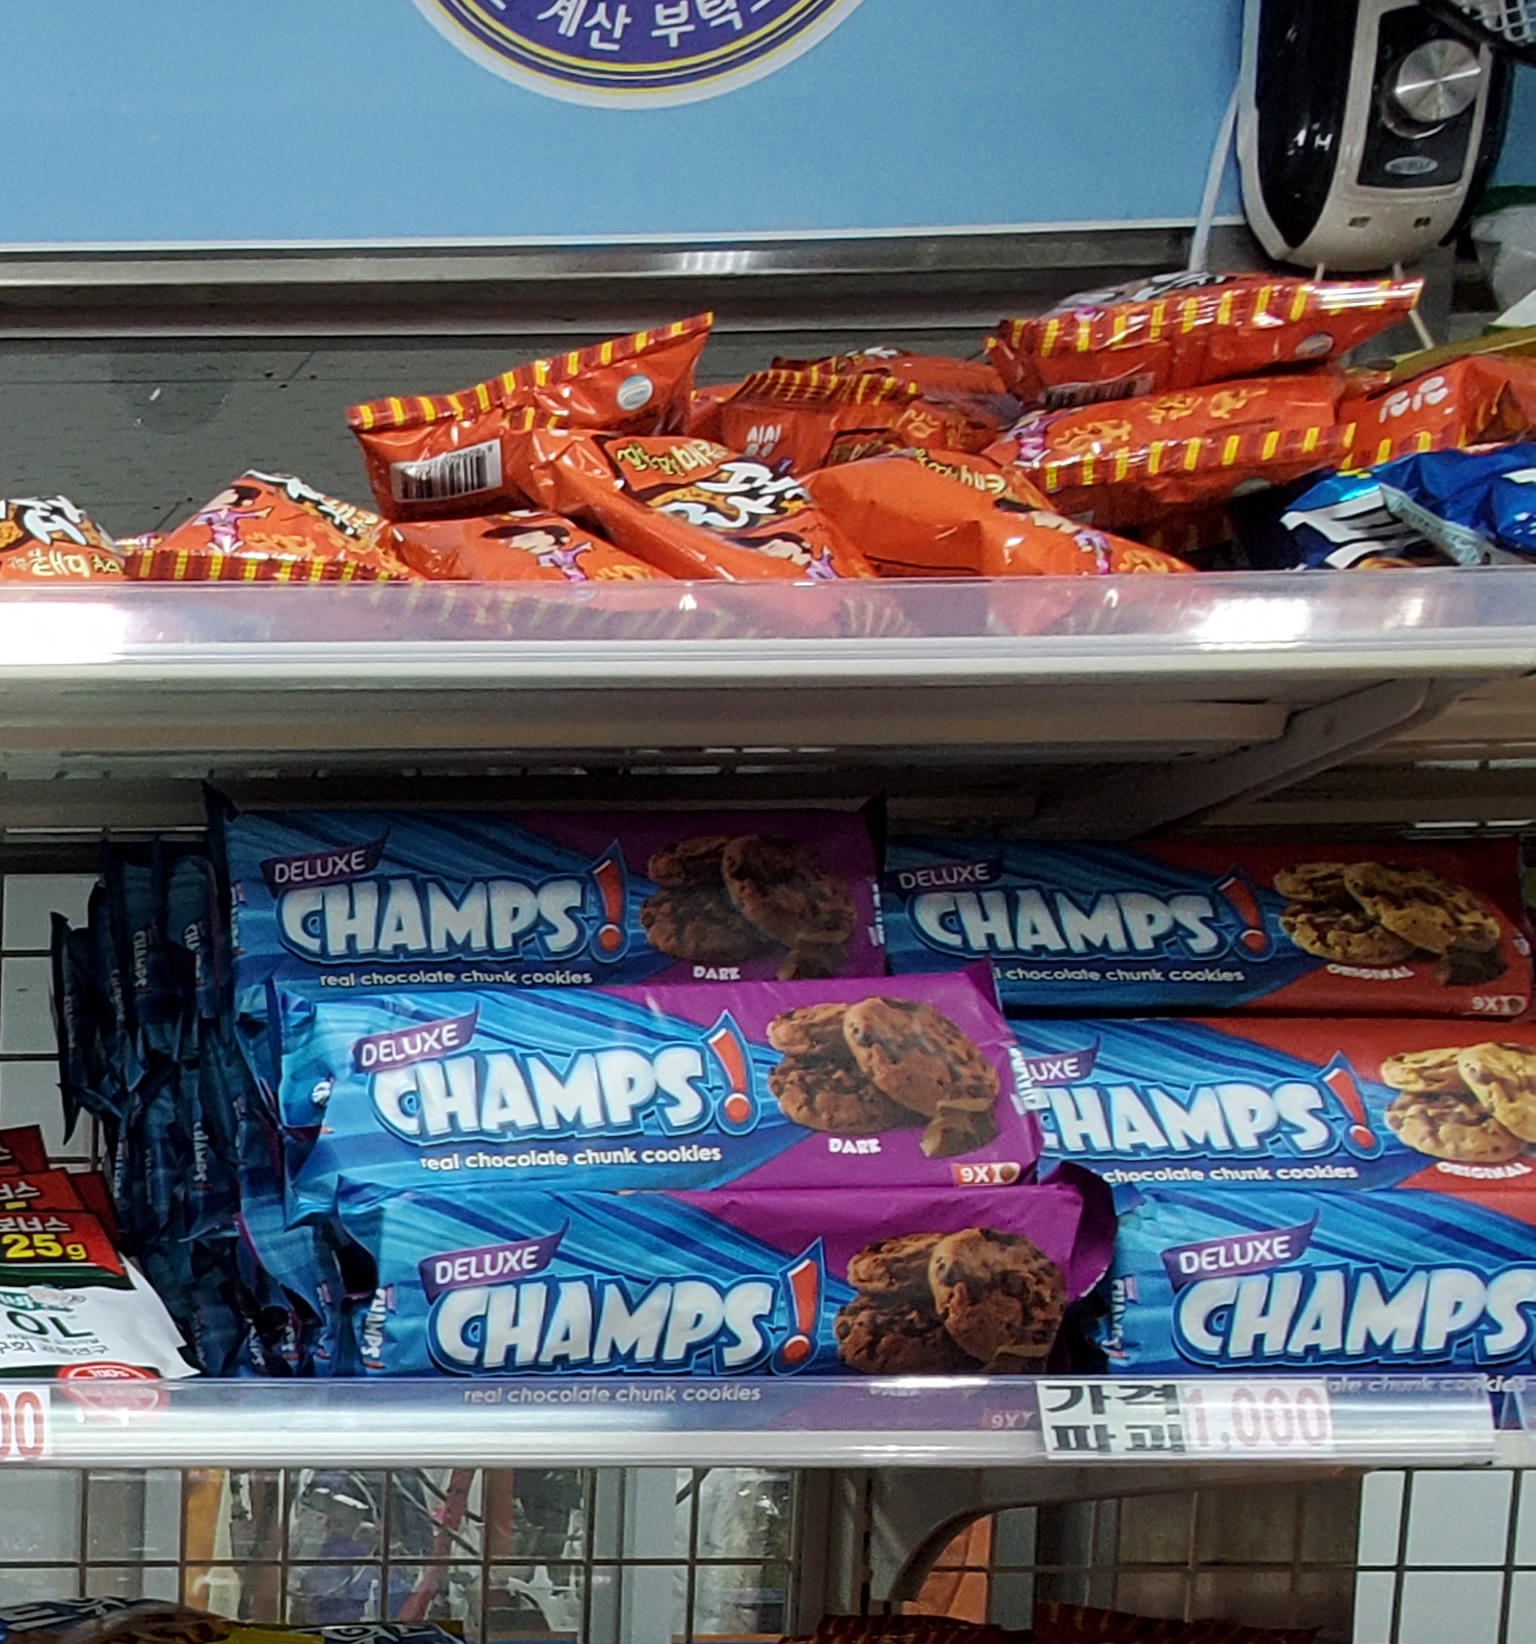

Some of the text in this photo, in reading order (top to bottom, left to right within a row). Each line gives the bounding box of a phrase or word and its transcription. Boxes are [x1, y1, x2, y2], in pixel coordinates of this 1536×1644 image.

[272, 849, 367, 885] DELUXE
[898, 862, 991, 890] DELUXE
[320, 970, 593, 988] real chocolate chunk cookies
[693, 966, 740, 980] DARK
[1005, 968, 1245, 983] chocolate chunk cookies
[1327, 964, 1416, 980] ORIGINAL
[360, 1023, 460, 1067] DELUXE
[420, 1144, 722, 1170] real chocolate chunk cookies
[828, 1139, 880, 1155] DARK
[1102, 1165, 1358, 1185] chocolate chunk cookies
[1436, 1161, 1532, 1179] ORIGINAL
[2, 1234, 87, 1261] 25g
[1179, 1236, 1292, 1275] DELUXE
[434, 1244, 541, 1285] DELUXE
[463, 1384, 762, 1404] real chocolate chunk cookies
